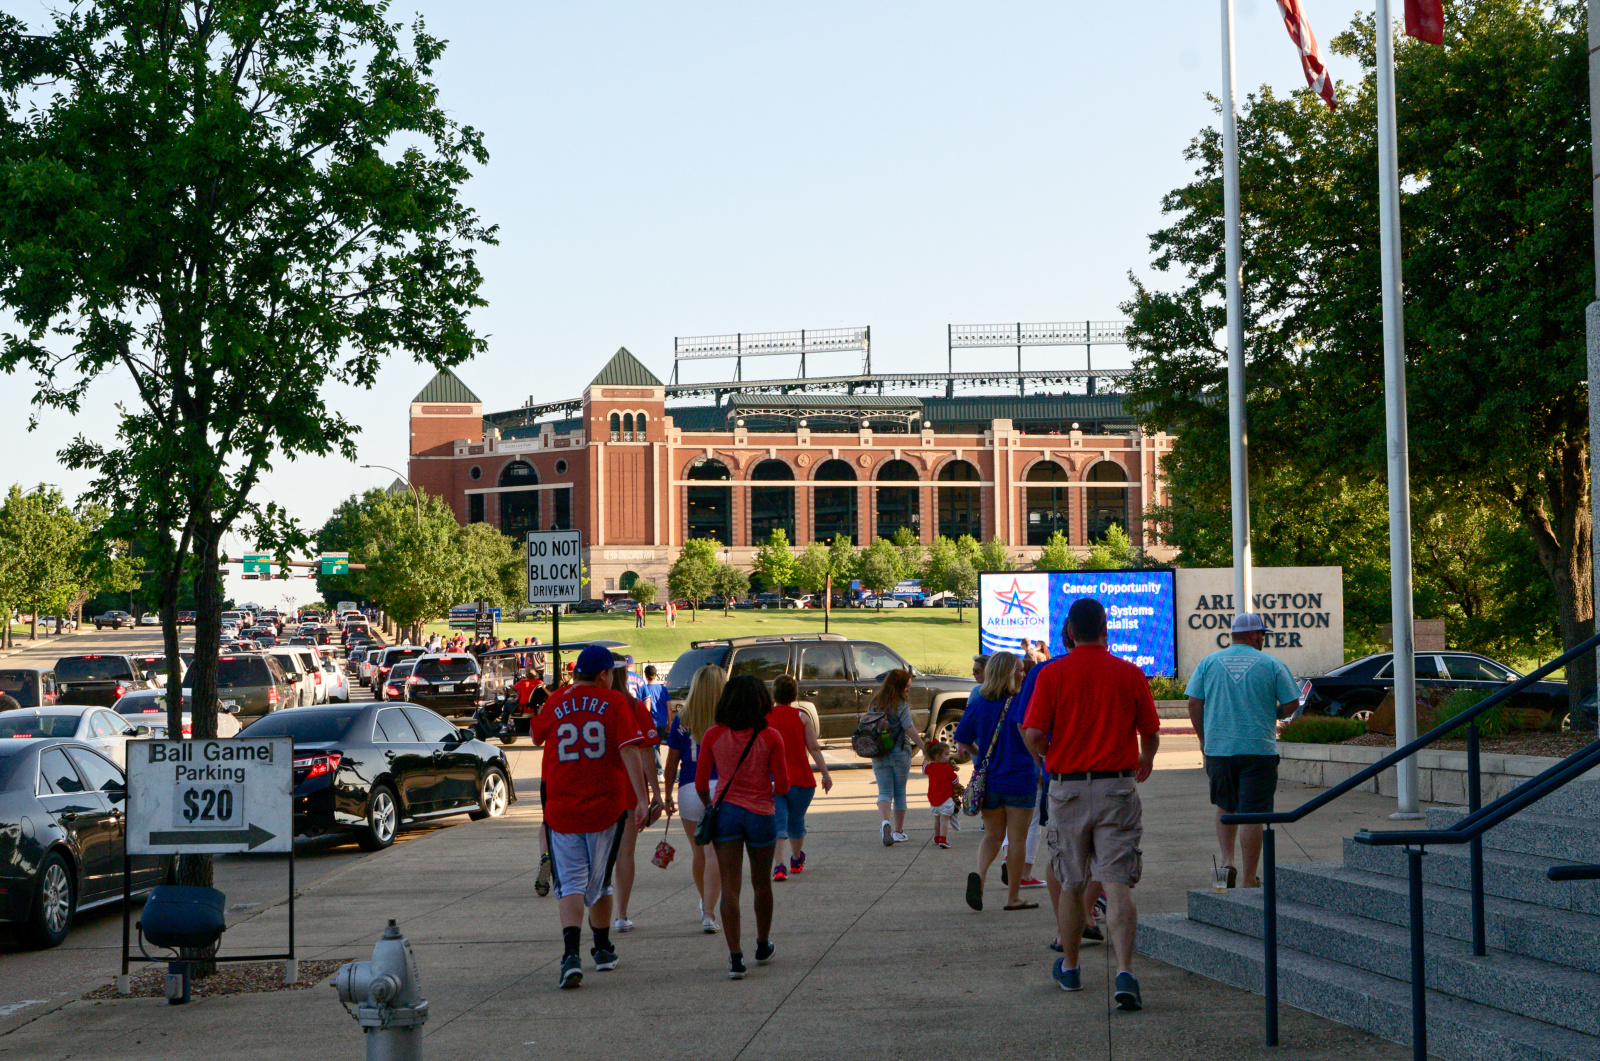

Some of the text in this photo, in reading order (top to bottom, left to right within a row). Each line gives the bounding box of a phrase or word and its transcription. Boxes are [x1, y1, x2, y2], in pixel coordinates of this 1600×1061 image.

[530, 540, 578, 557] DO NOT
[531, 563, 578, 580] BLOCK
[533, 585, 576, 597] DRIVEWAY
[1062, 582, 1161, 595] Career Opportunity
[1195, 593, 1323, 610] ARLNGTON
[1110, 605, 1154, 618] Systems
[987, 617, 1045, 626] ARLINGTON
[1107, 619, 1139, 629] cialist
[1188, 612, 1330, 629] CONNTION
[1216, 632, 1303, 649] CTER
[554, 696, 610, 720] BELTRE
[557, 720, 607, 762] 29
[151, 742, 271, 762] Ball Game
[175, 764, 246, 783] Parking
[183, 787, 233, 823] $20
